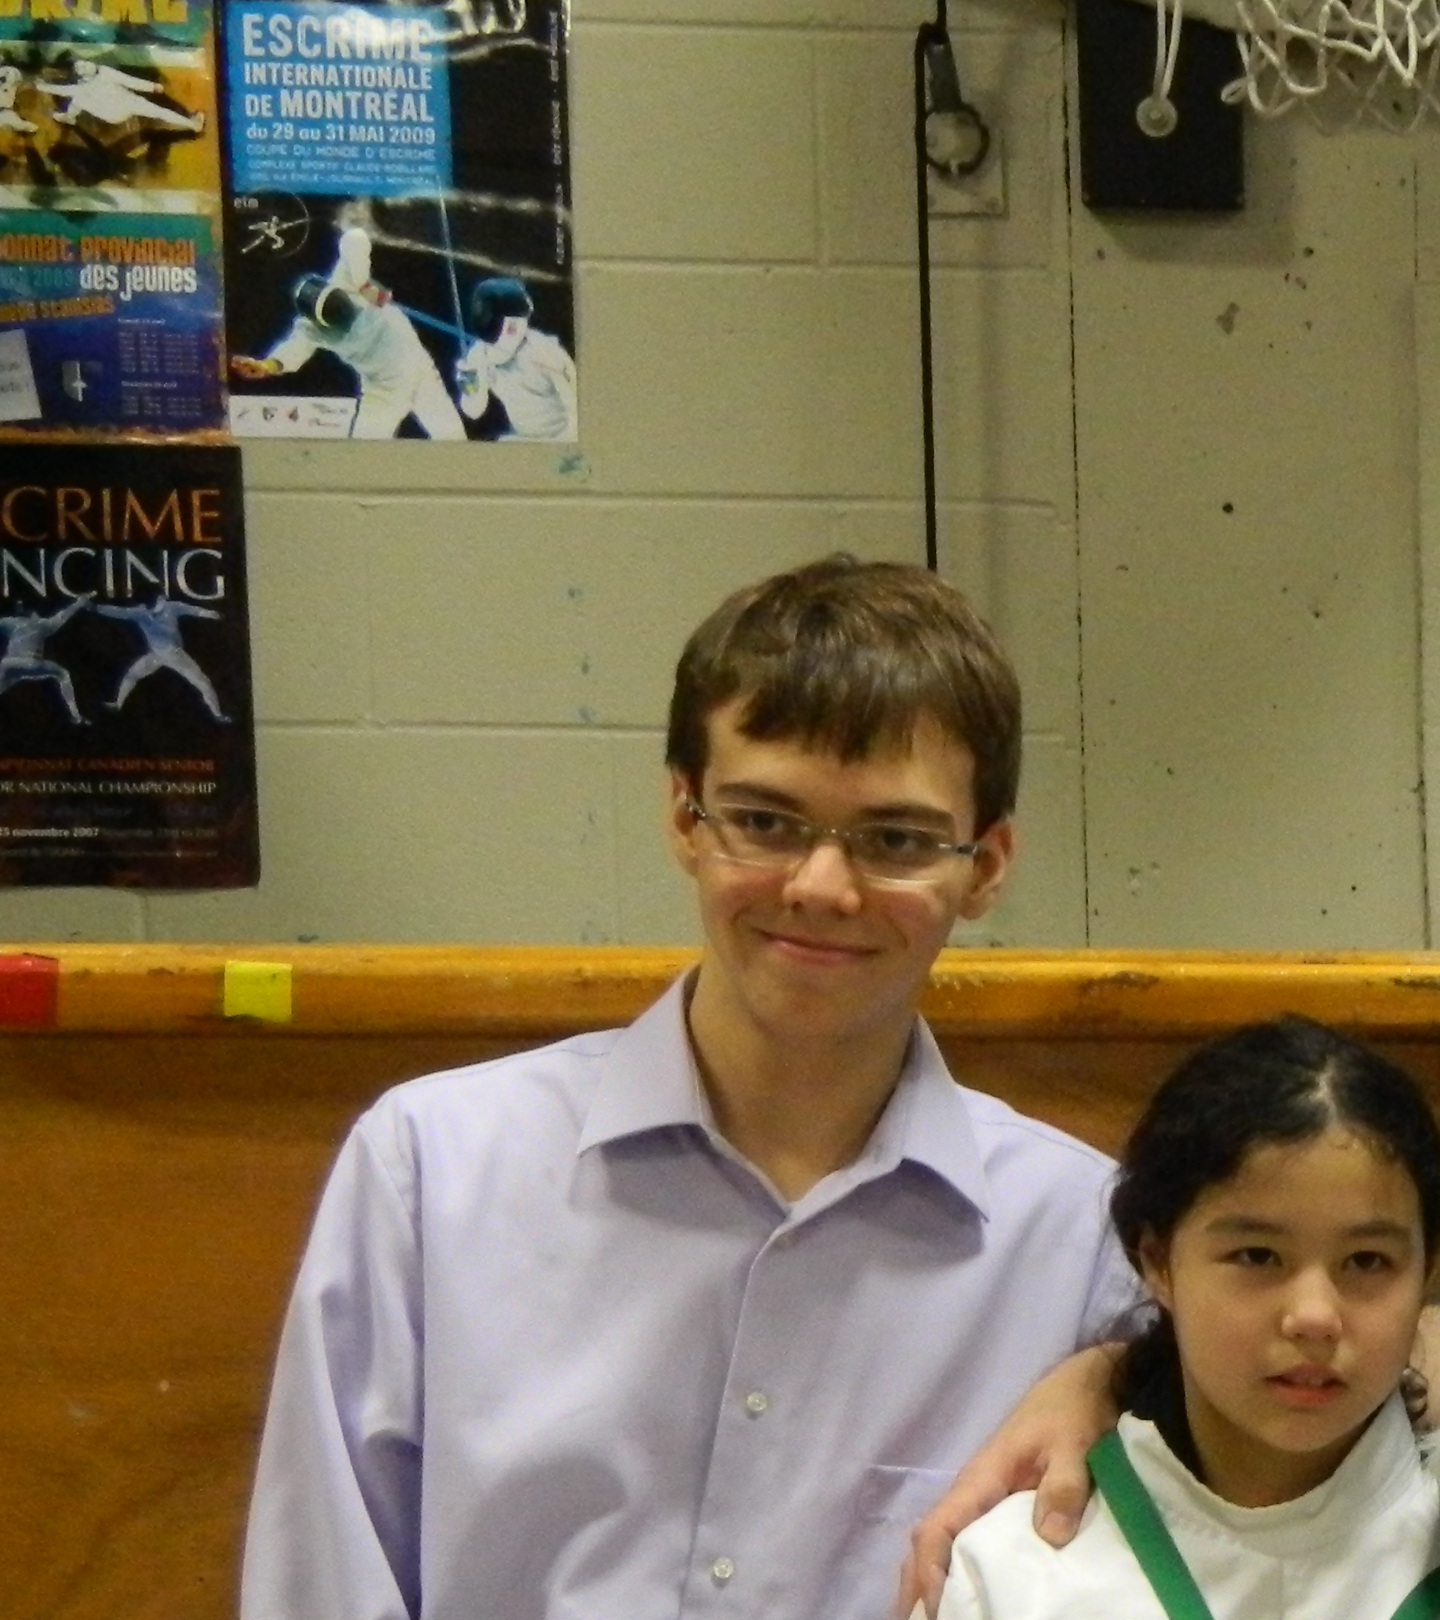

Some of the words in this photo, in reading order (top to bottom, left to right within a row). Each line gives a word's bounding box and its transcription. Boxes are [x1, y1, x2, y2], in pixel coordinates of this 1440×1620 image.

[242, 13, 433, 61] ESCRIME
[243, 62, 433, 91] INTERNATIONALE
[244, 94, 274, 119] DE
[279, 88, 435, 122] MONTRÉAL
[246, 122, 268, 140] du
[299, 126, 322, 141] au
[325, 123, 345, 142] 31
[350, 124, 385, 143] MAI
[389, 126, 436, 145] 2009
[80, 264, 120, 291] des
[120, 265, 198, 301] jeunes
[18, 780, 93, 794] NATIONAL
[98, 780, 217, 794] CHAMPIONSHIP
